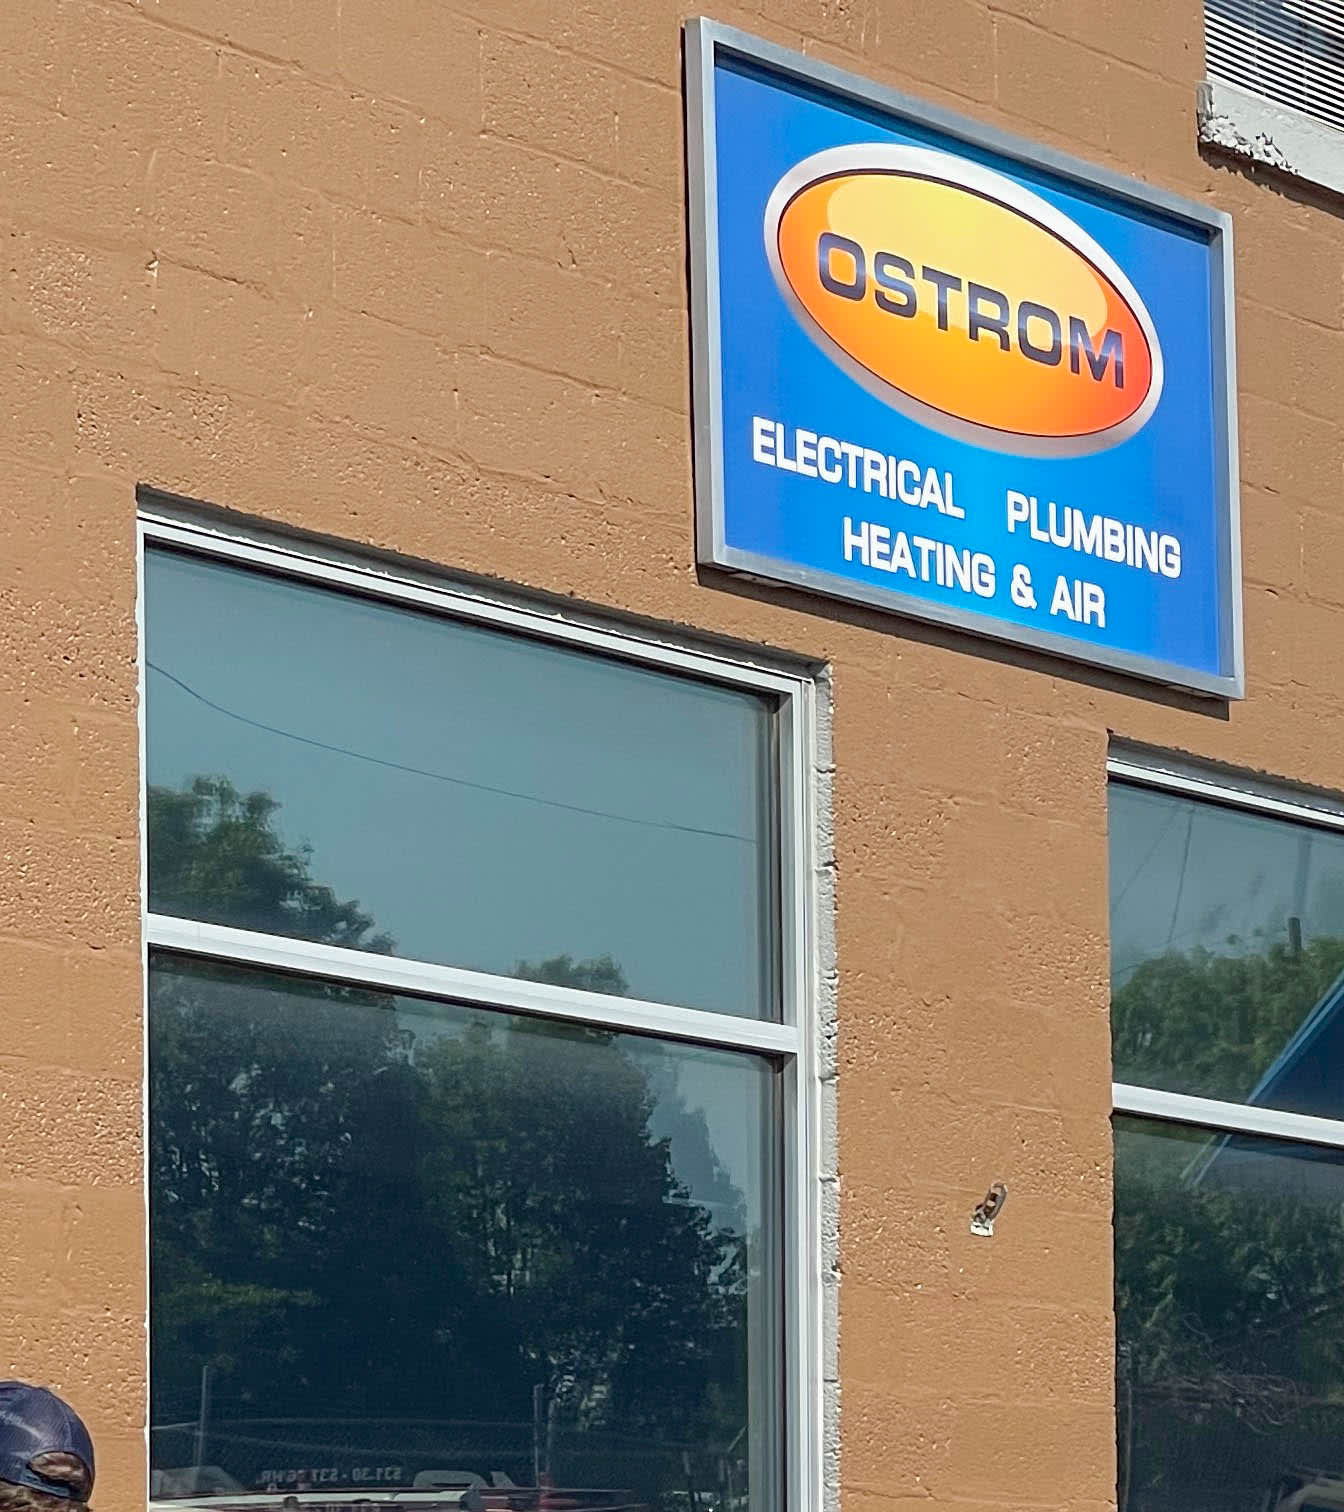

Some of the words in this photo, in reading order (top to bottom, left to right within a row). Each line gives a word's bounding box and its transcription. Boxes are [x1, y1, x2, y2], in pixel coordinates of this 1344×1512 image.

[817, 232, 1126, 388] OSTROM
[752, 416, 966, 519] ELECTRICAL
[1007, 489, 1181, 578] PLUMBING
[842, 517, 996, 598] HEATING
[1010, 565, 1038, 610] &
[1049, 575, 1106, 629] AIR
